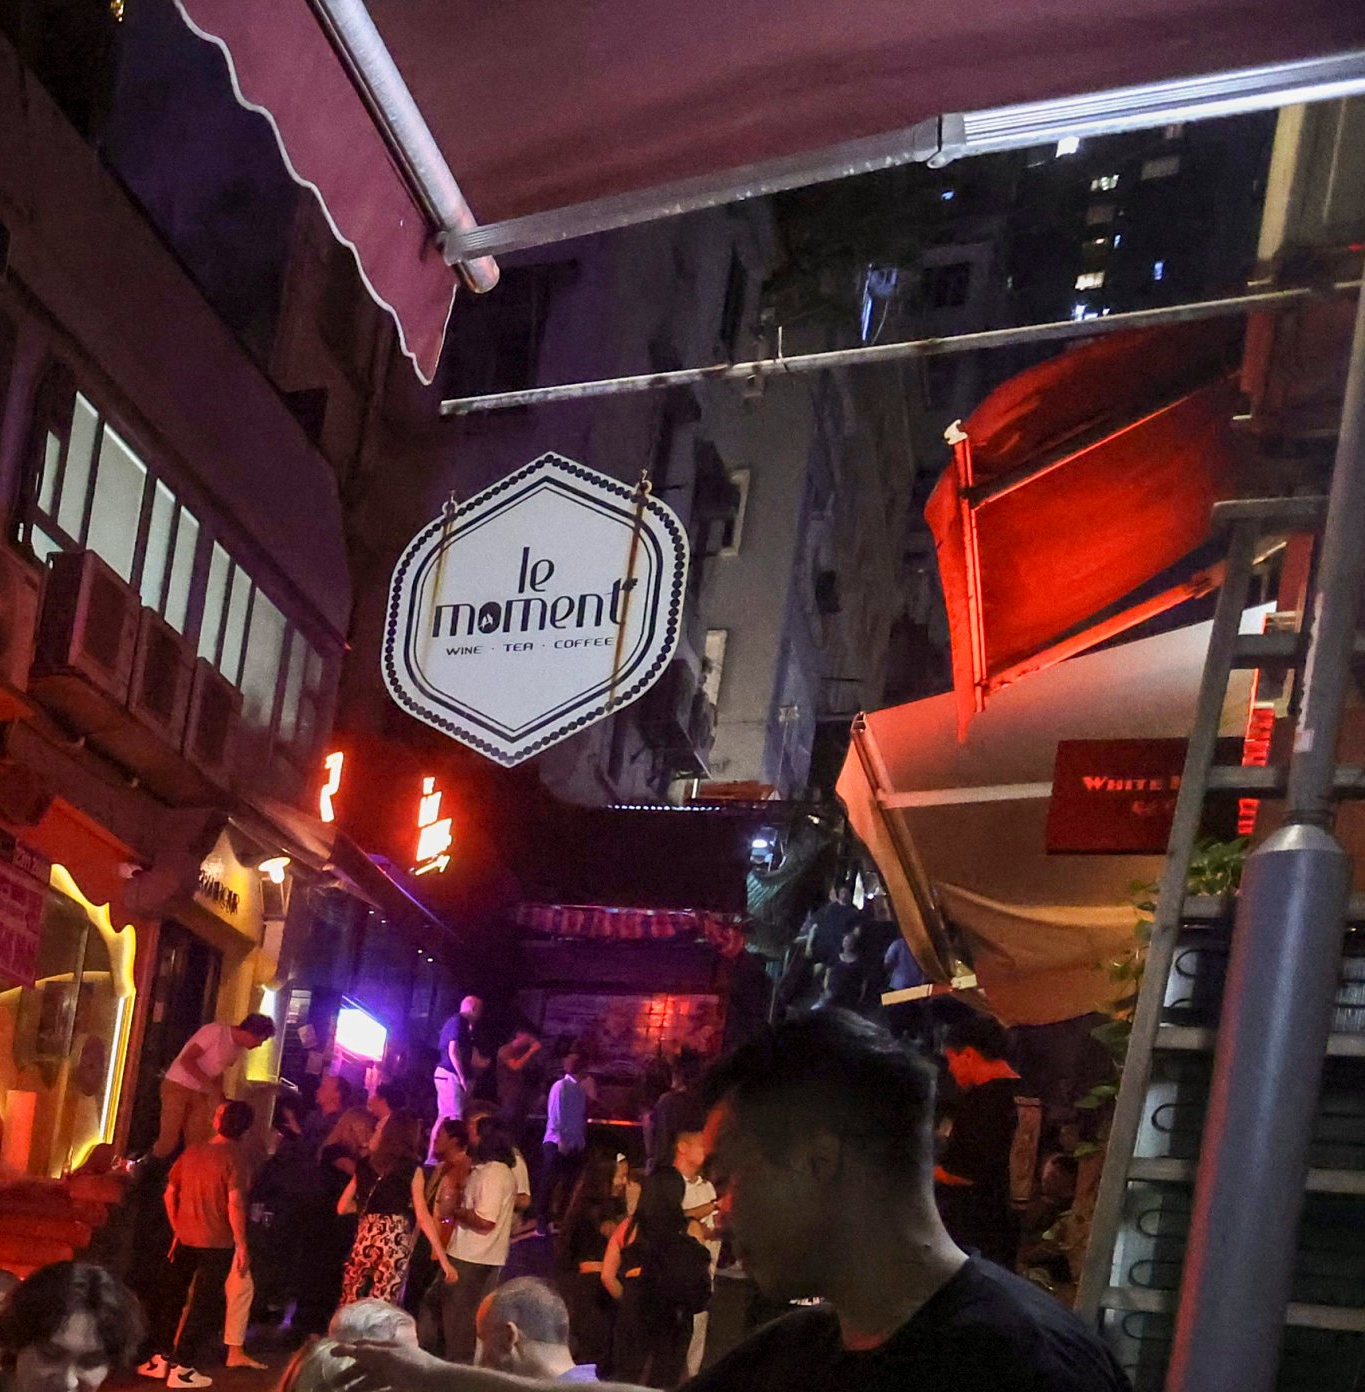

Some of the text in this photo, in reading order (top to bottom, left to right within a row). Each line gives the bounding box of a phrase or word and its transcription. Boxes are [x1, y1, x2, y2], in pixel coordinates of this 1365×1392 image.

[518, 546, 555, 594] le
[431, 577, 630, 639] moment
[445, 636, 615, 657] WINE TEA COFFEE
